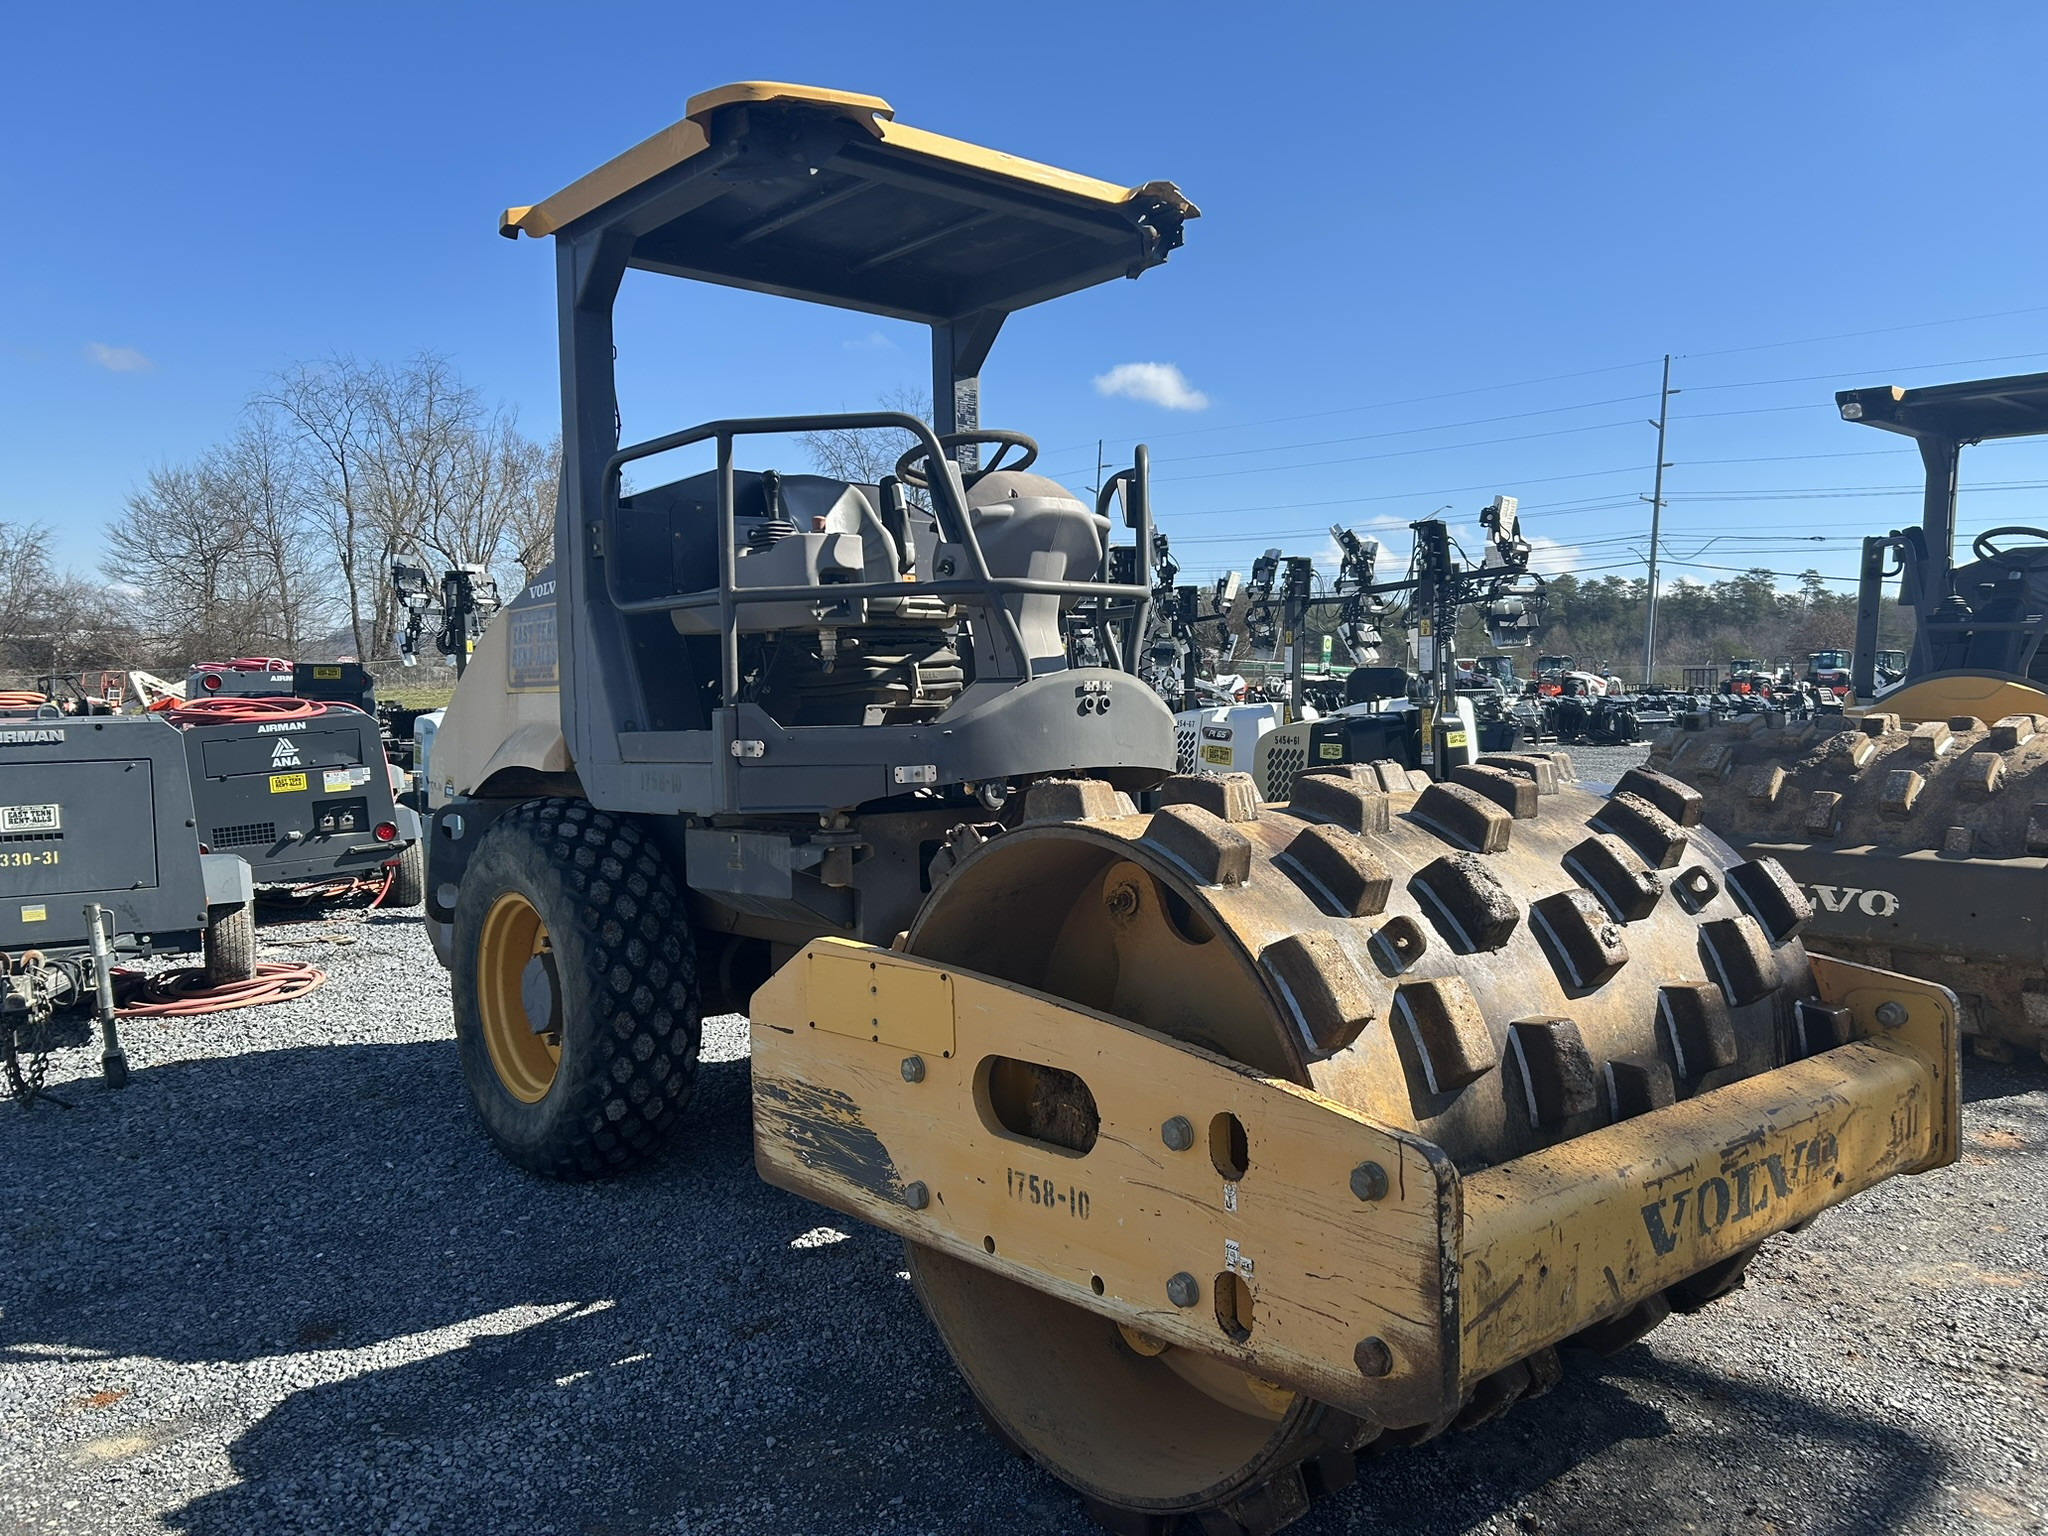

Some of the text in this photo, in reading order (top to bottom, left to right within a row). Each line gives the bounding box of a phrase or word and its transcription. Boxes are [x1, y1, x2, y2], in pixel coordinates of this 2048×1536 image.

[257, 721, 307, 733] AIRMAN
[1274, 735, 1300, 745] 5454-61
[272, 755, 302, 767] ANA
[30, 809, 52, 817] TENN
[8, 816, 53, 825] RENT-ALLS
[0, 850, 59, 867] 330-31
[1006, 1166, 1090, 1221] 1758-10
